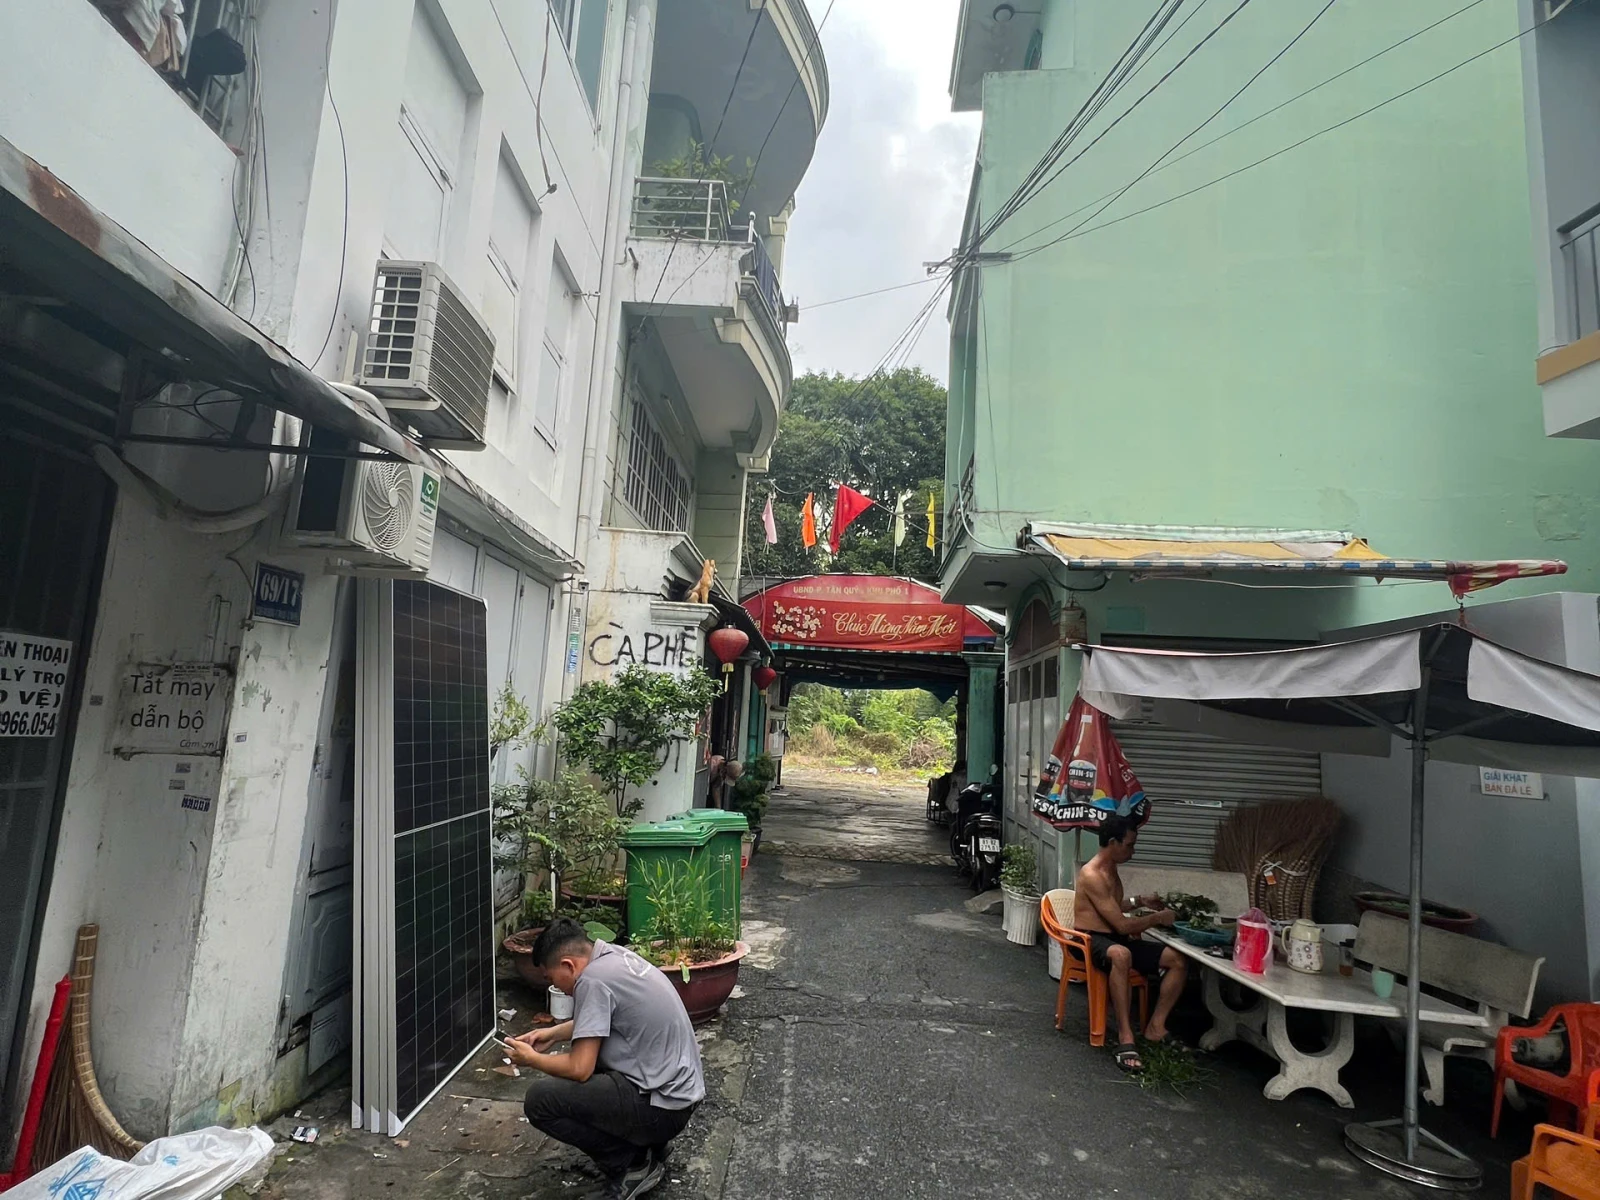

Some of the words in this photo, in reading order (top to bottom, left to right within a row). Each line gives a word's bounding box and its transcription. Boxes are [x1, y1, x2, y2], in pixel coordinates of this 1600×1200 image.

[260, 573, 300, 607] 69/17
[833, 612, 868, 636] Chúc
[864, 613, 902, 640] Mừng
[900, 615, 928, 637] Năm
[921, 614, 957, 640] Mới
[23, 643, 69, 666] THOẠI
[33, 670, 65, 688] TRỌ
[130, 671, 164, 694] Tắt
[19, 689, 61, 708] VỆ)
[130, 704, 170, 728] dẫn
[178, 709, 204, 733] bộ
[1069, 768, 1094, 778] CHIN-SU
[1056, 805, 1107, 821] CHIN-SU
